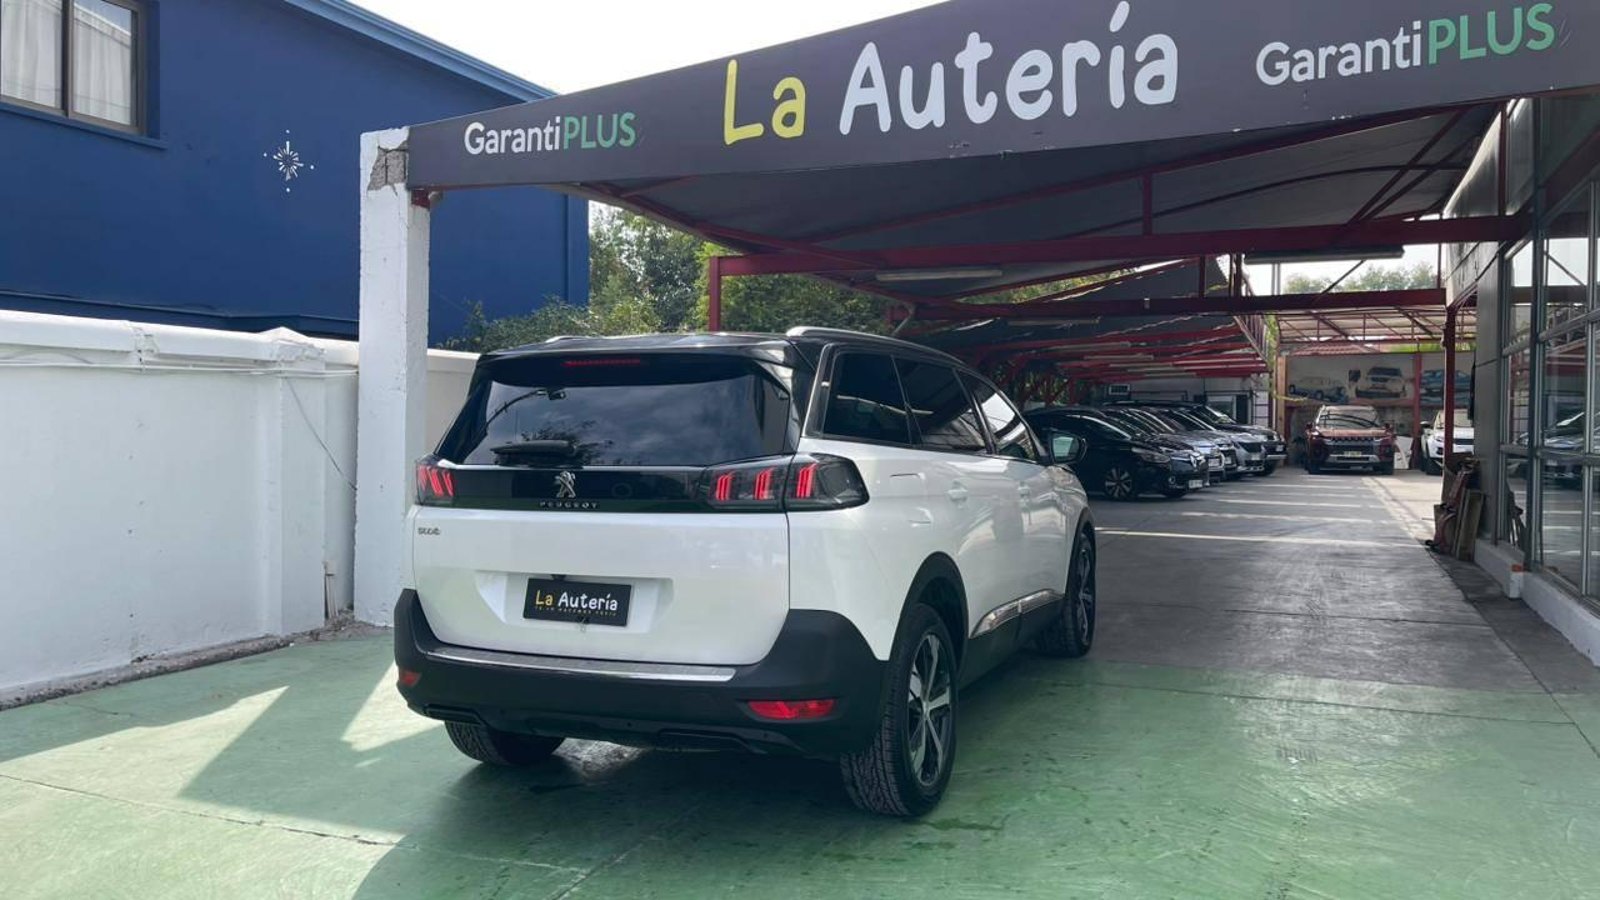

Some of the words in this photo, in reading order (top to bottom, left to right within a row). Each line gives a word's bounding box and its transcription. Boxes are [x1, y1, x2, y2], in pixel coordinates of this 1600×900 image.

[1255, 2, 1556, 86] GarantiPLUS
[724, 58, 806, 145] La
[839, 1, 1178, 135] Autería
[463, 111, 637, 156] GarantiPLUS
[540, 501, 598, 509] PEUGEOT
[535, 590, 554, 606] La
[557, 591, 619, 612] Autería
